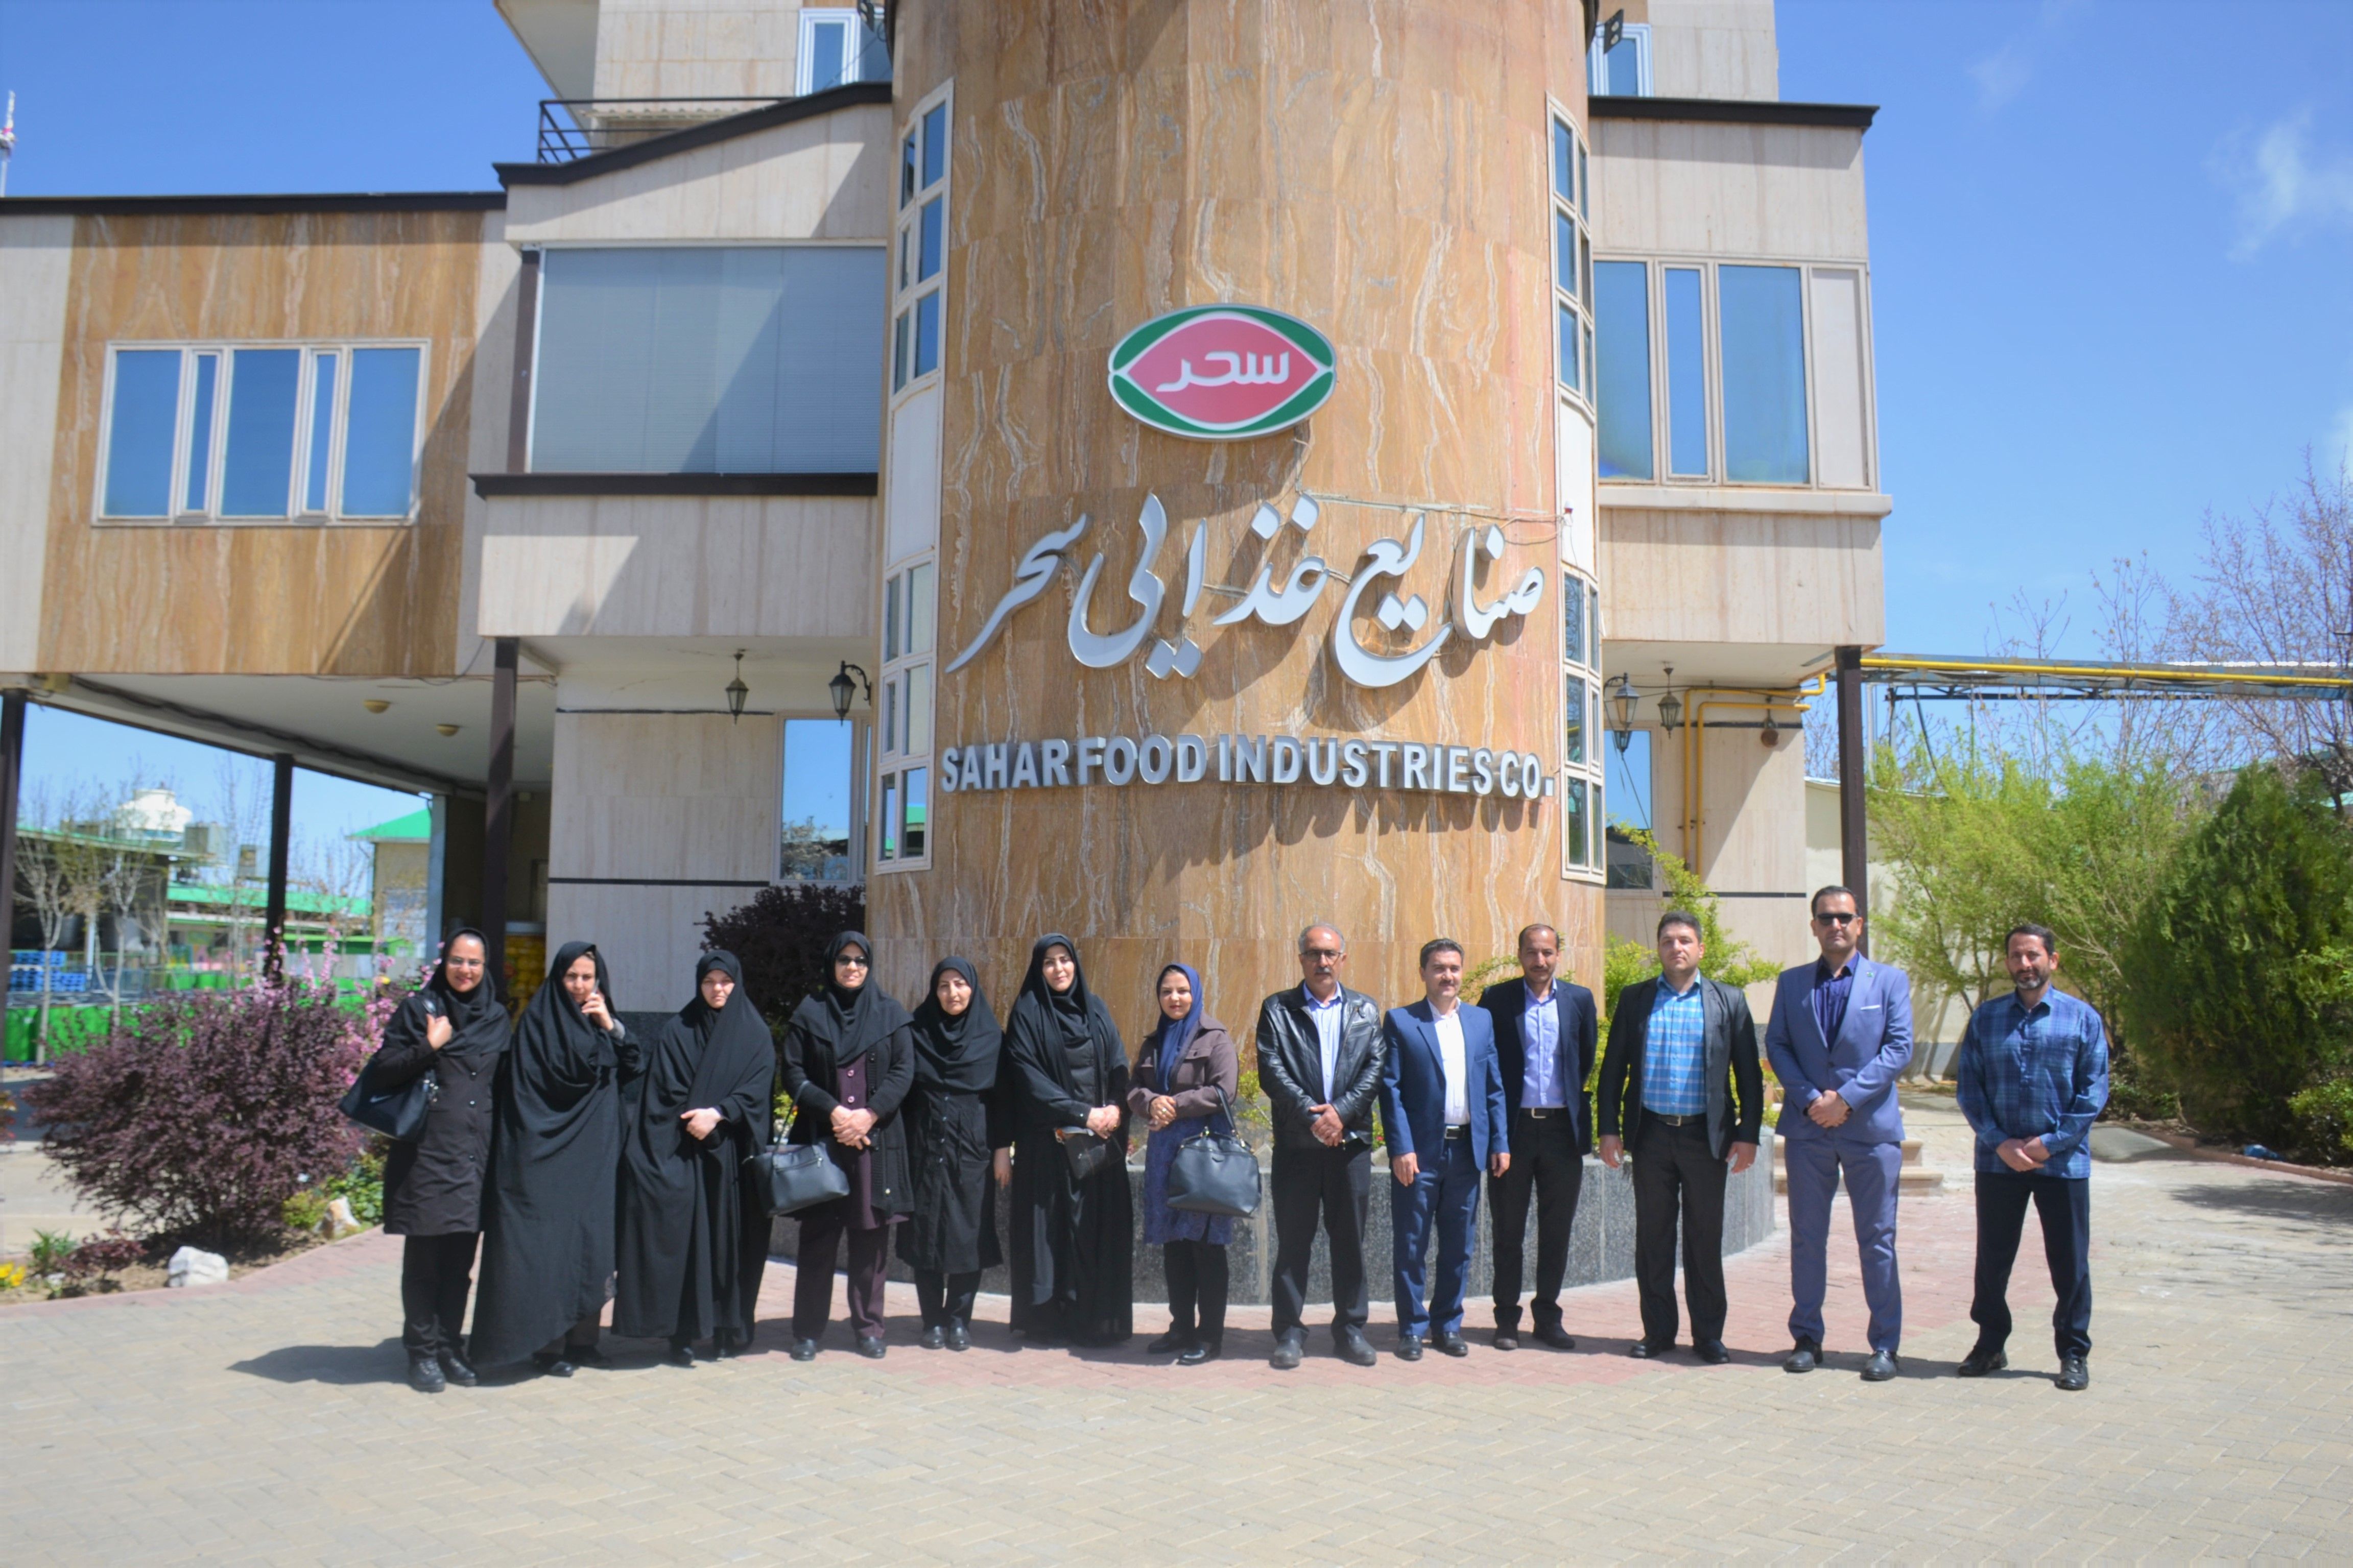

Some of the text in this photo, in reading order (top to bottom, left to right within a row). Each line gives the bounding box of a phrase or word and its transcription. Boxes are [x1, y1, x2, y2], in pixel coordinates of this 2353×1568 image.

[1155, 351, 1289, 392] سحر
[945, 513, 1091, 673] سحر
[941, 733, 1555, 799] SAHAR FOOD INDUSTRIES CO.
